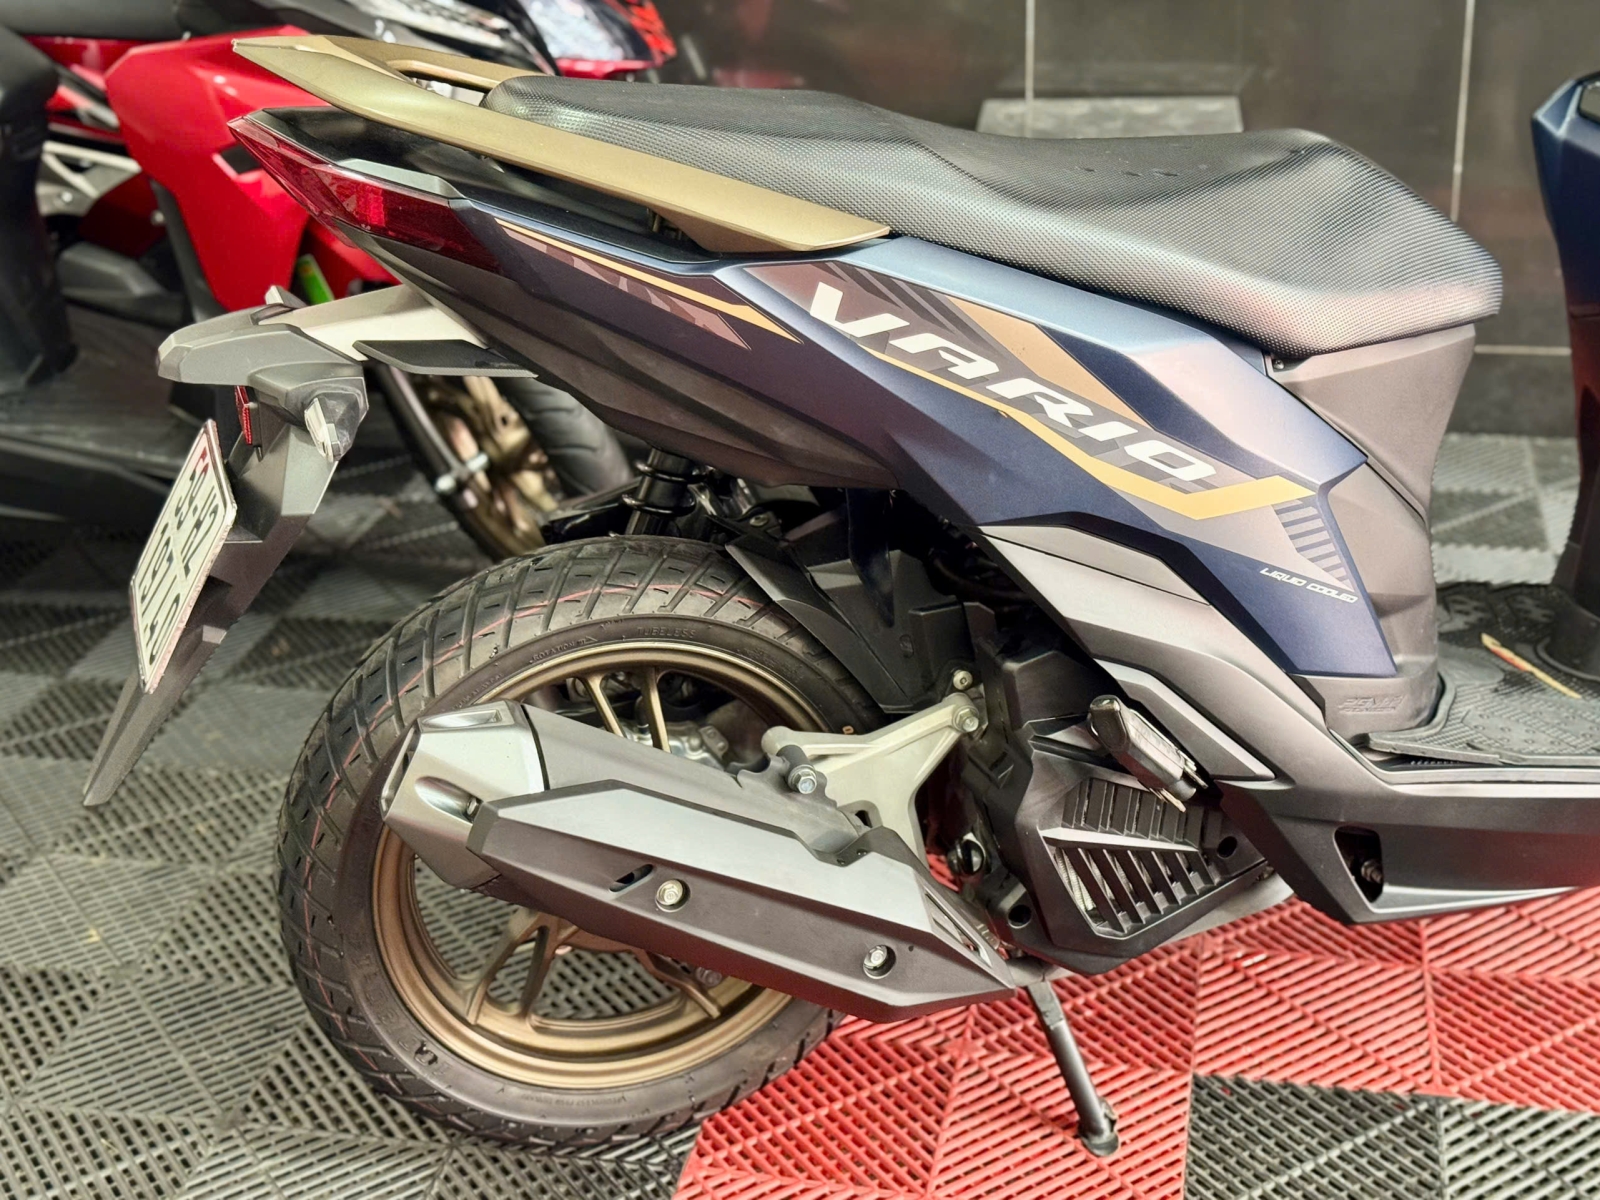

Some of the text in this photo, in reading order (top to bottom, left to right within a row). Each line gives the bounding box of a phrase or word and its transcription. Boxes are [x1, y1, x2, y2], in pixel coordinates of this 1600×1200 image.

[810, 282, 1216, 481] VARIO
[1260, 567, 1358, 603] LIQUID COOLED
